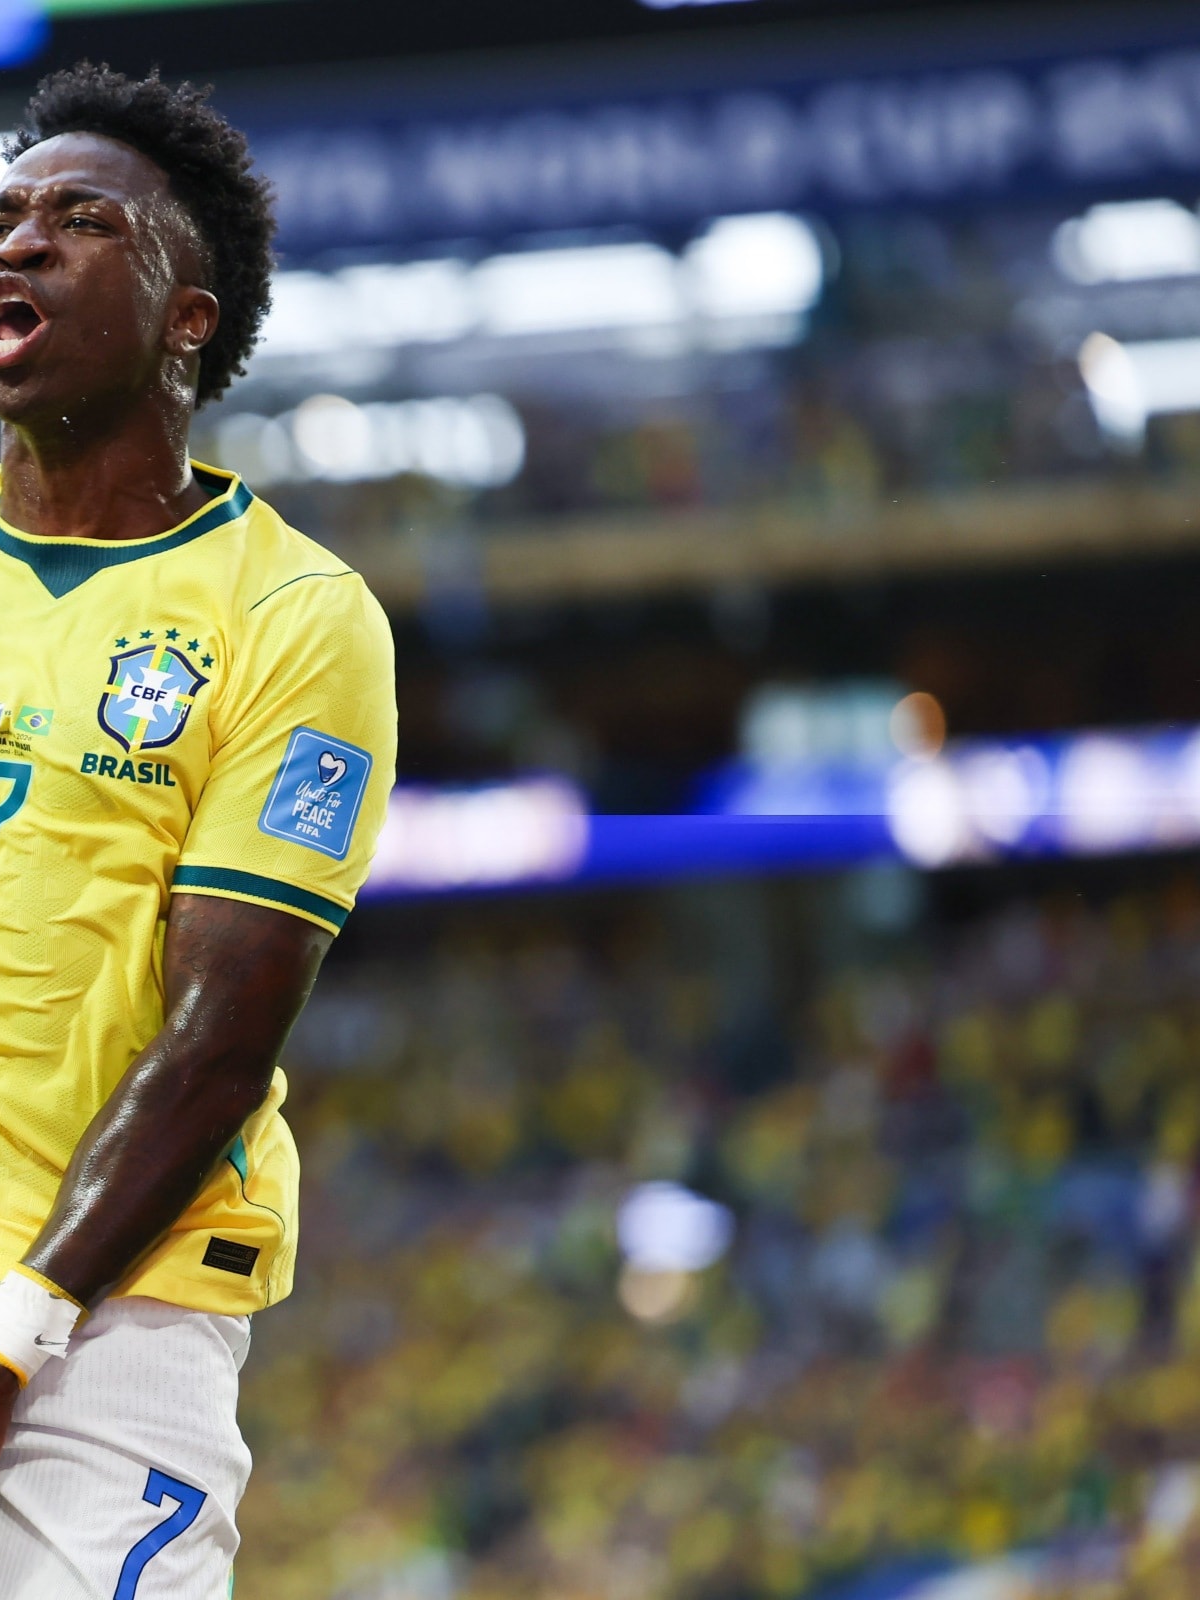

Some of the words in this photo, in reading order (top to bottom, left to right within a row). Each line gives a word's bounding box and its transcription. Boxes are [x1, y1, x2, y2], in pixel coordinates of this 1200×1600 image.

[130, 684, 168, 703] CBF
[80, 752, 177, 787] BRASIL
[295, 780, 327, 802] Unite
[325, 790, 343, 808] For
[291, 799, 336, 829] PEACE
[295, 821, 320, 837] FIFA
[113, 1467, 209, 1600] 7
